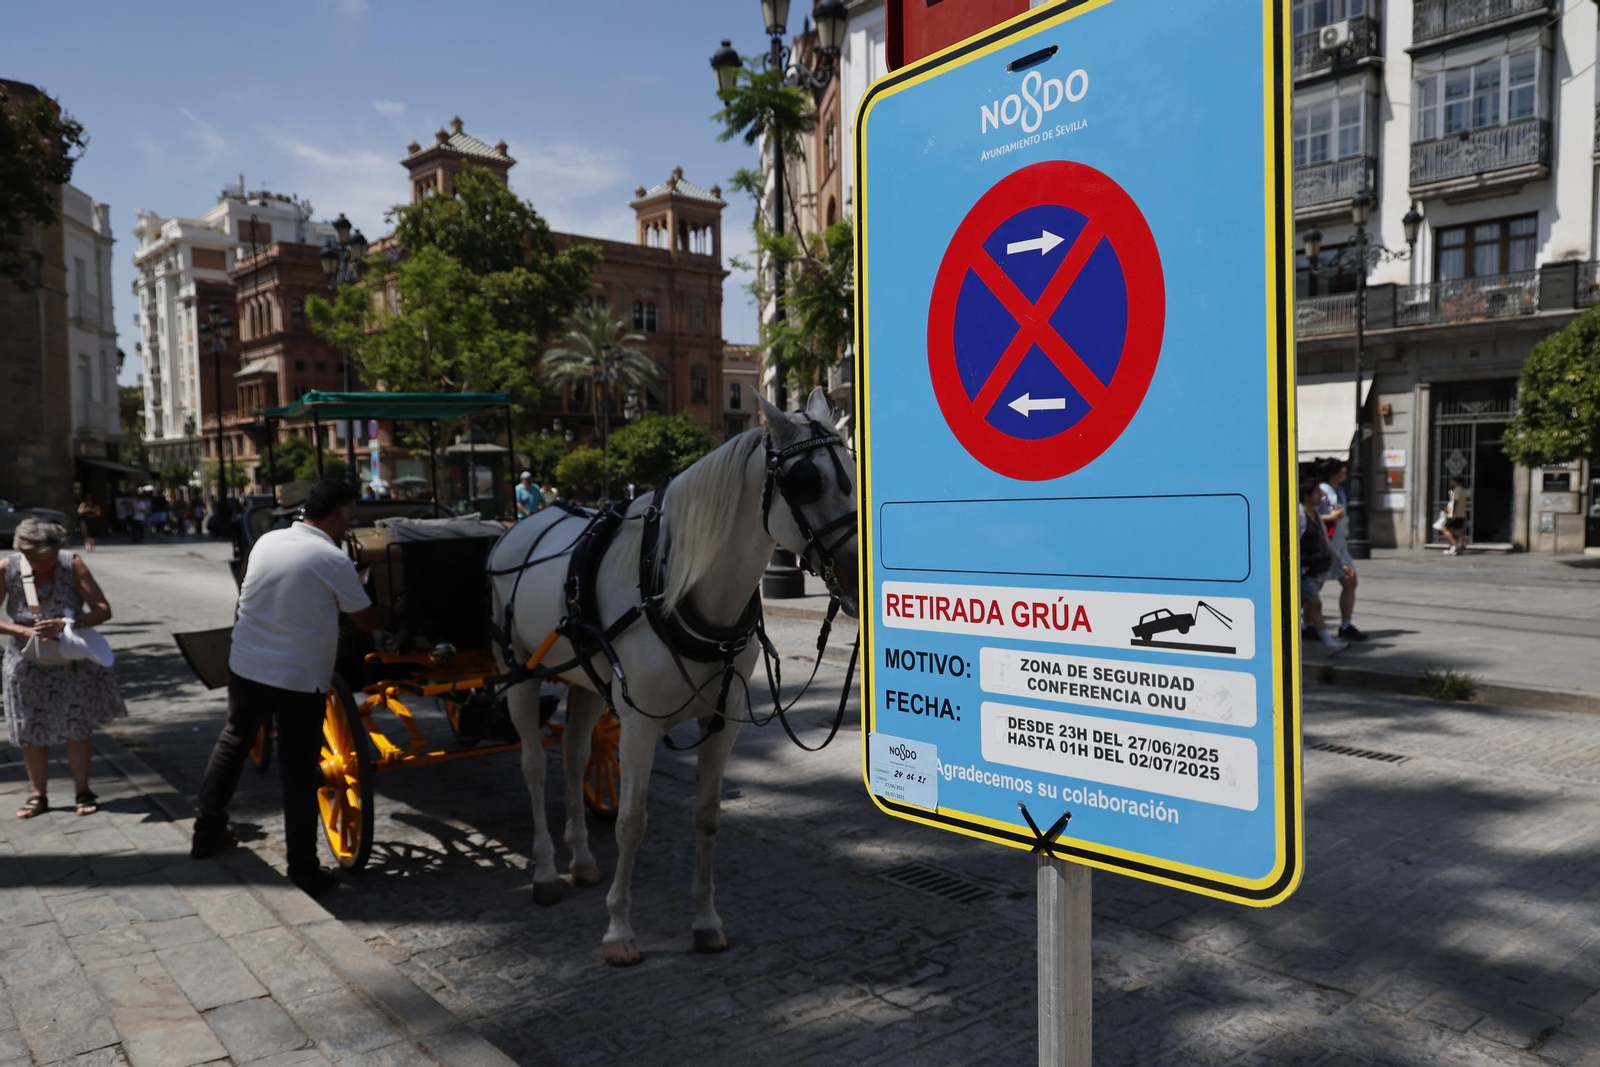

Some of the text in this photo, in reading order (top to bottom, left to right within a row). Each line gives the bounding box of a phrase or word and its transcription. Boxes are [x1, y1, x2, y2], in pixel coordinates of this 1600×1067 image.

[1042, 129, 1054, 141] DE
[886, 593, 1093, 633] RETIRADA GRÚA
[885, 648, 971, 678] MOTIVO:
[1020, 658, 1195, 692] ZONA DE SEGURIDAD
[885, 690, 961, 721] FECHA:
[1027, 677, 1187, 711] CONFERENCIA ONU
[1007, 732, 1220, 781] HASTA 01H DEL 02/07/2025
[1008, 716, 1219, 763] DESDE 23H DEL 27/06/2025
[936, 757, 1179, 824] Agradecemos su colaboración
